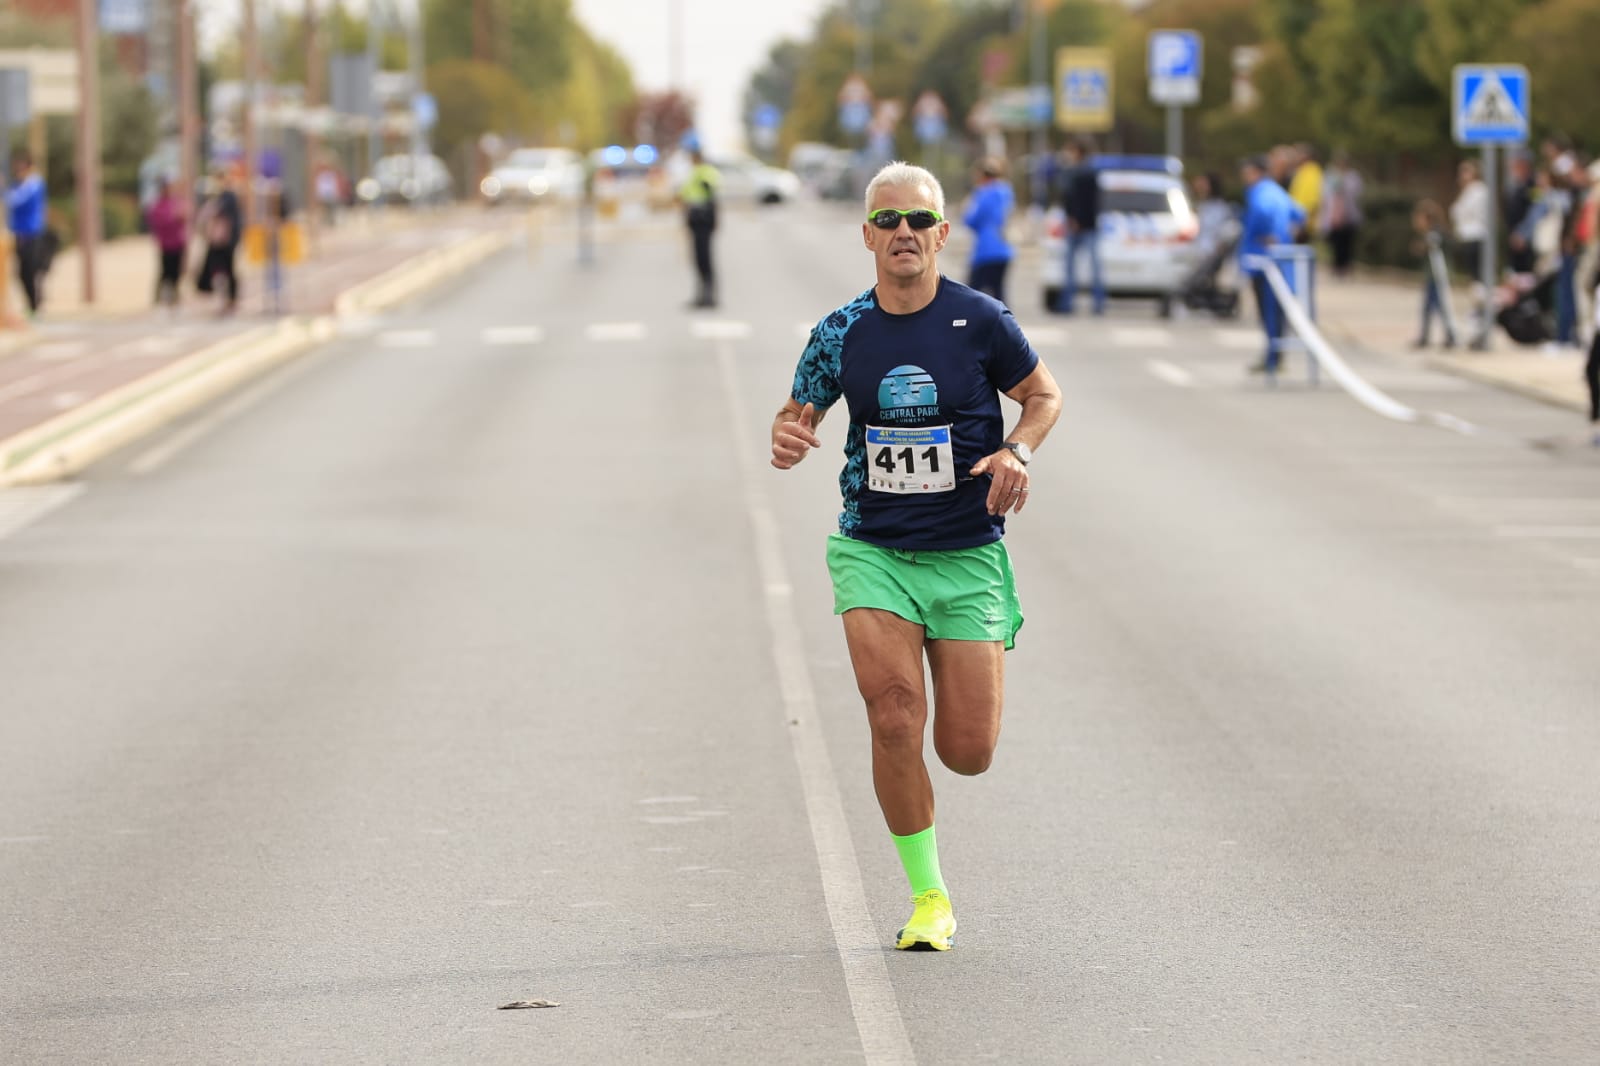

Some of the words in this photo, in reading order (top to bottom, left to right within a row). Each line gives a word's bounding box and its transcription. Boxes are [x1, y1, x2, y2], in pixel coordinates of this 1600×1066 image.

[880, 408, 916, 420] CENTRAL
[917, 406, 940, 416] PARK
[875, 446, 940, 474] 411
